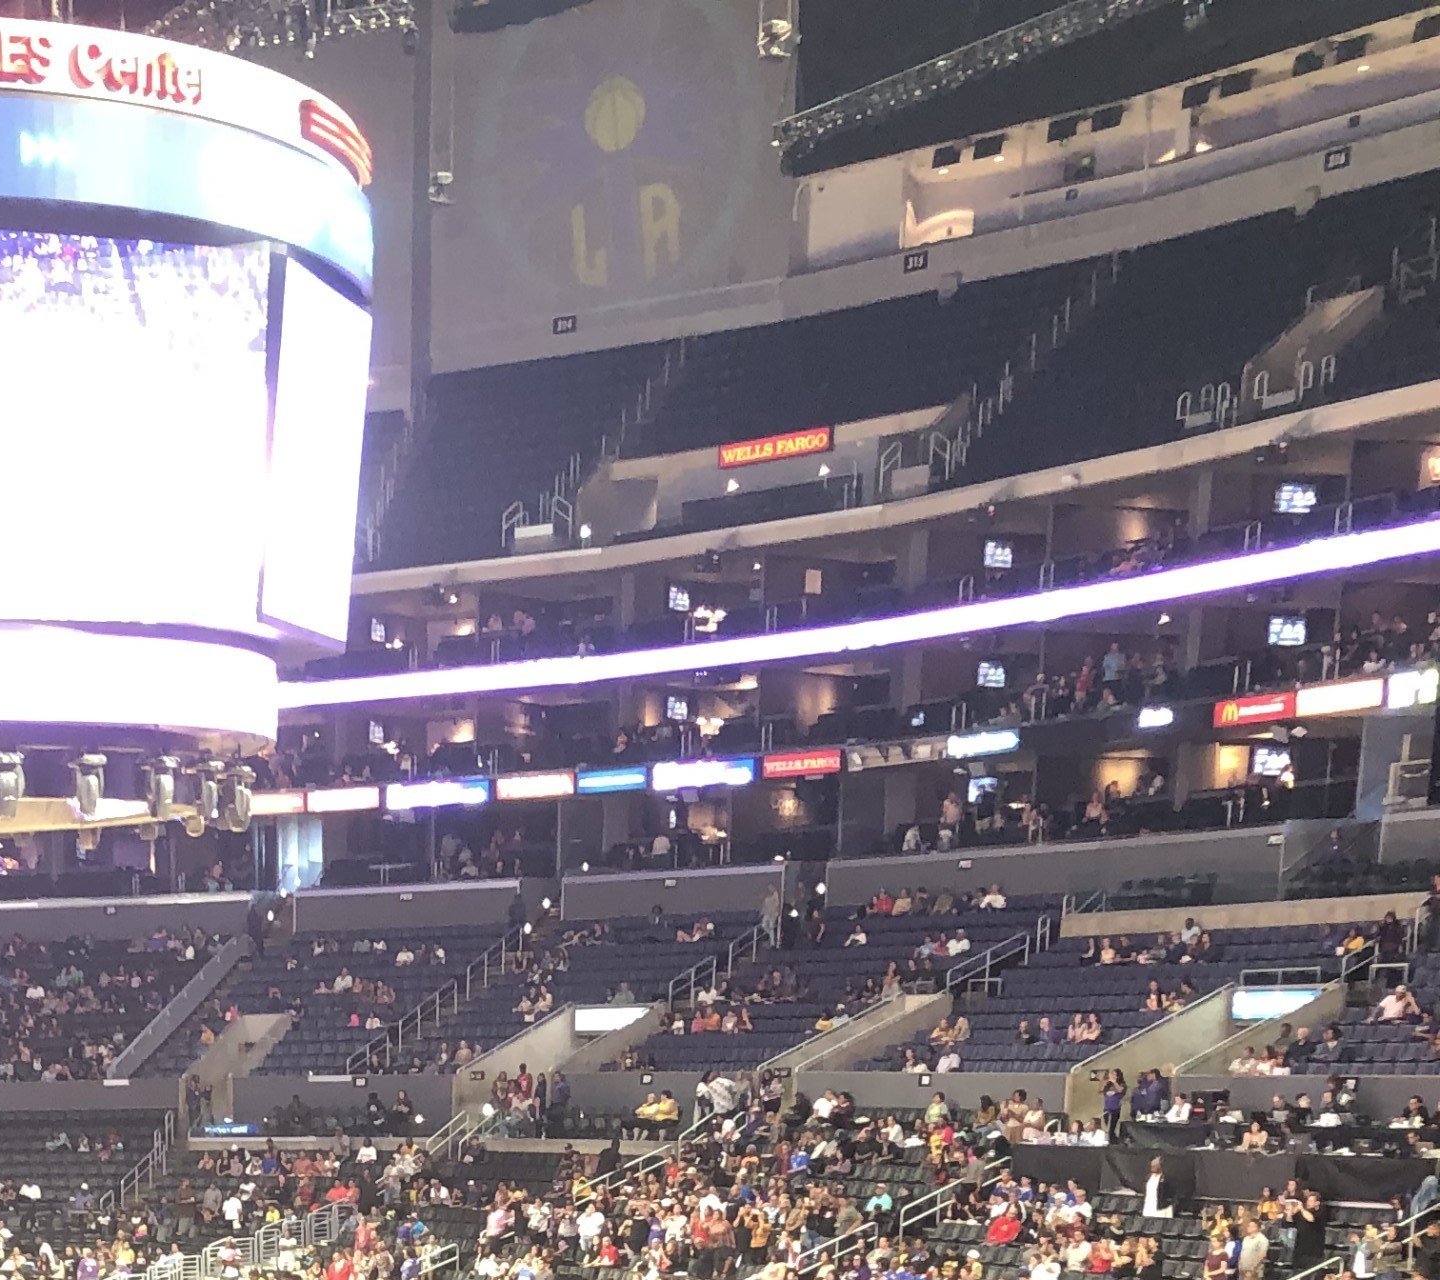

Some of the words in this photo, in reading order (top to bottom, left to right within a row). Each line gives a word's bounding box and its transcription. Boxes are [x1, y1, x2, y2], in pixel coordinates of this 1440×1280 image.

[68, 44, 204, 105] Cente
[721, 442, 772, 464] WELLS
[775, 433, 828, 455] FARGO
[764, 760, 802, 774] WELLS
[803, 756, 840, 770] FARGO
